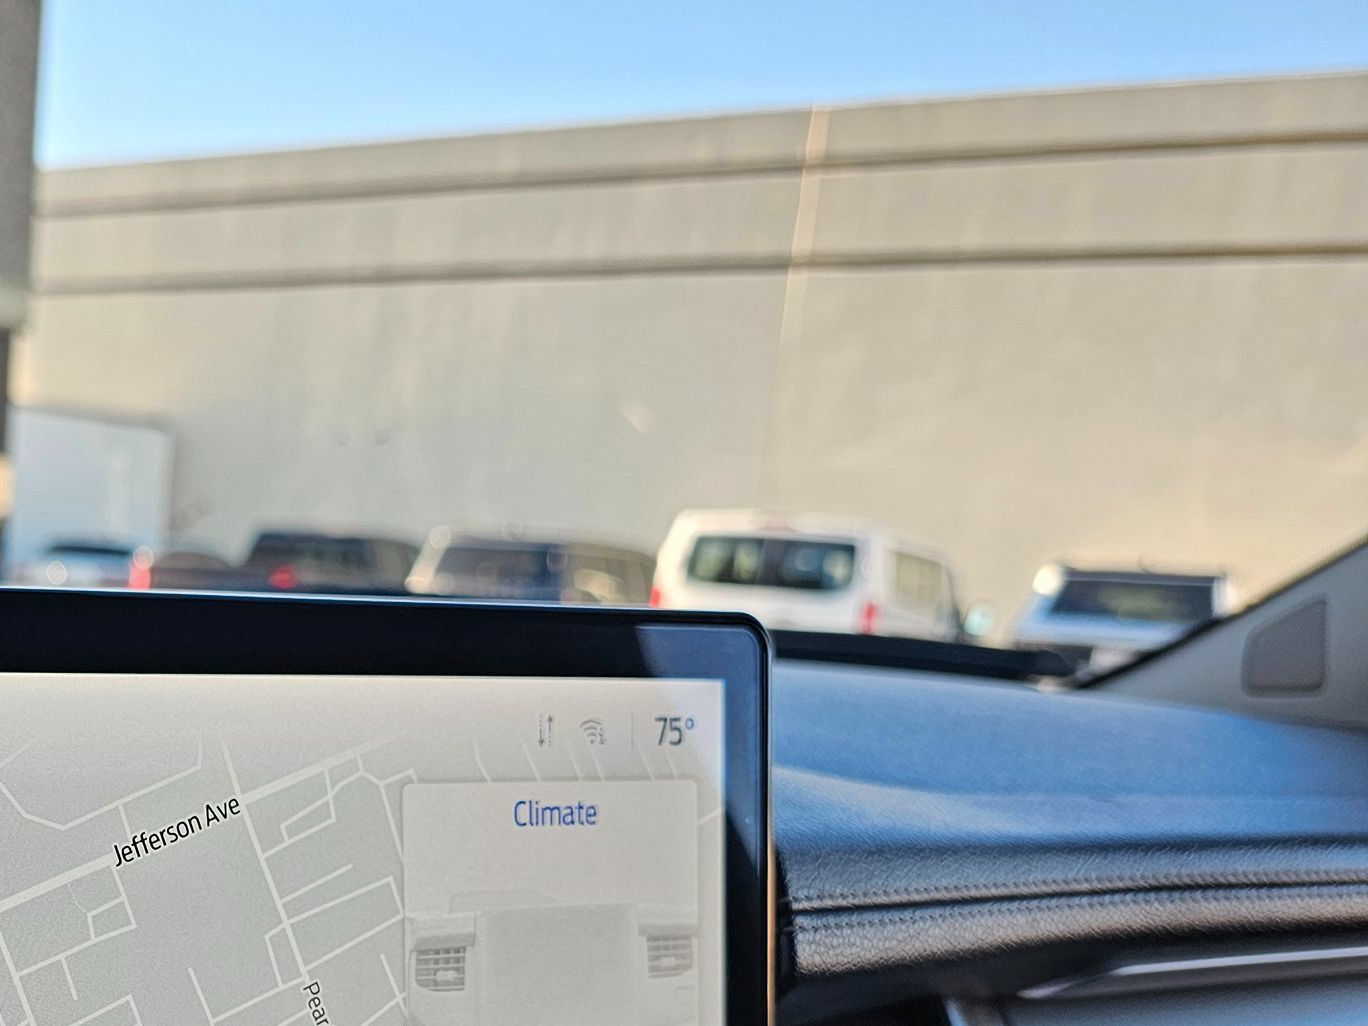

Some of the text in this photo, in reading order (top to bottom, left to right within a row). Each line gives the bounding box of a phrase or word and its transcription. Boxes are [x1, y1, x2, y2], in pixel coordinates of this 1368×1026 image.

[655, 716, 695, 746] 75°
[114, 797, 242, 867] Jefferson Ave
[514, 801, 598, 827] Climate
[303, 981, 329, 1026] Pear
